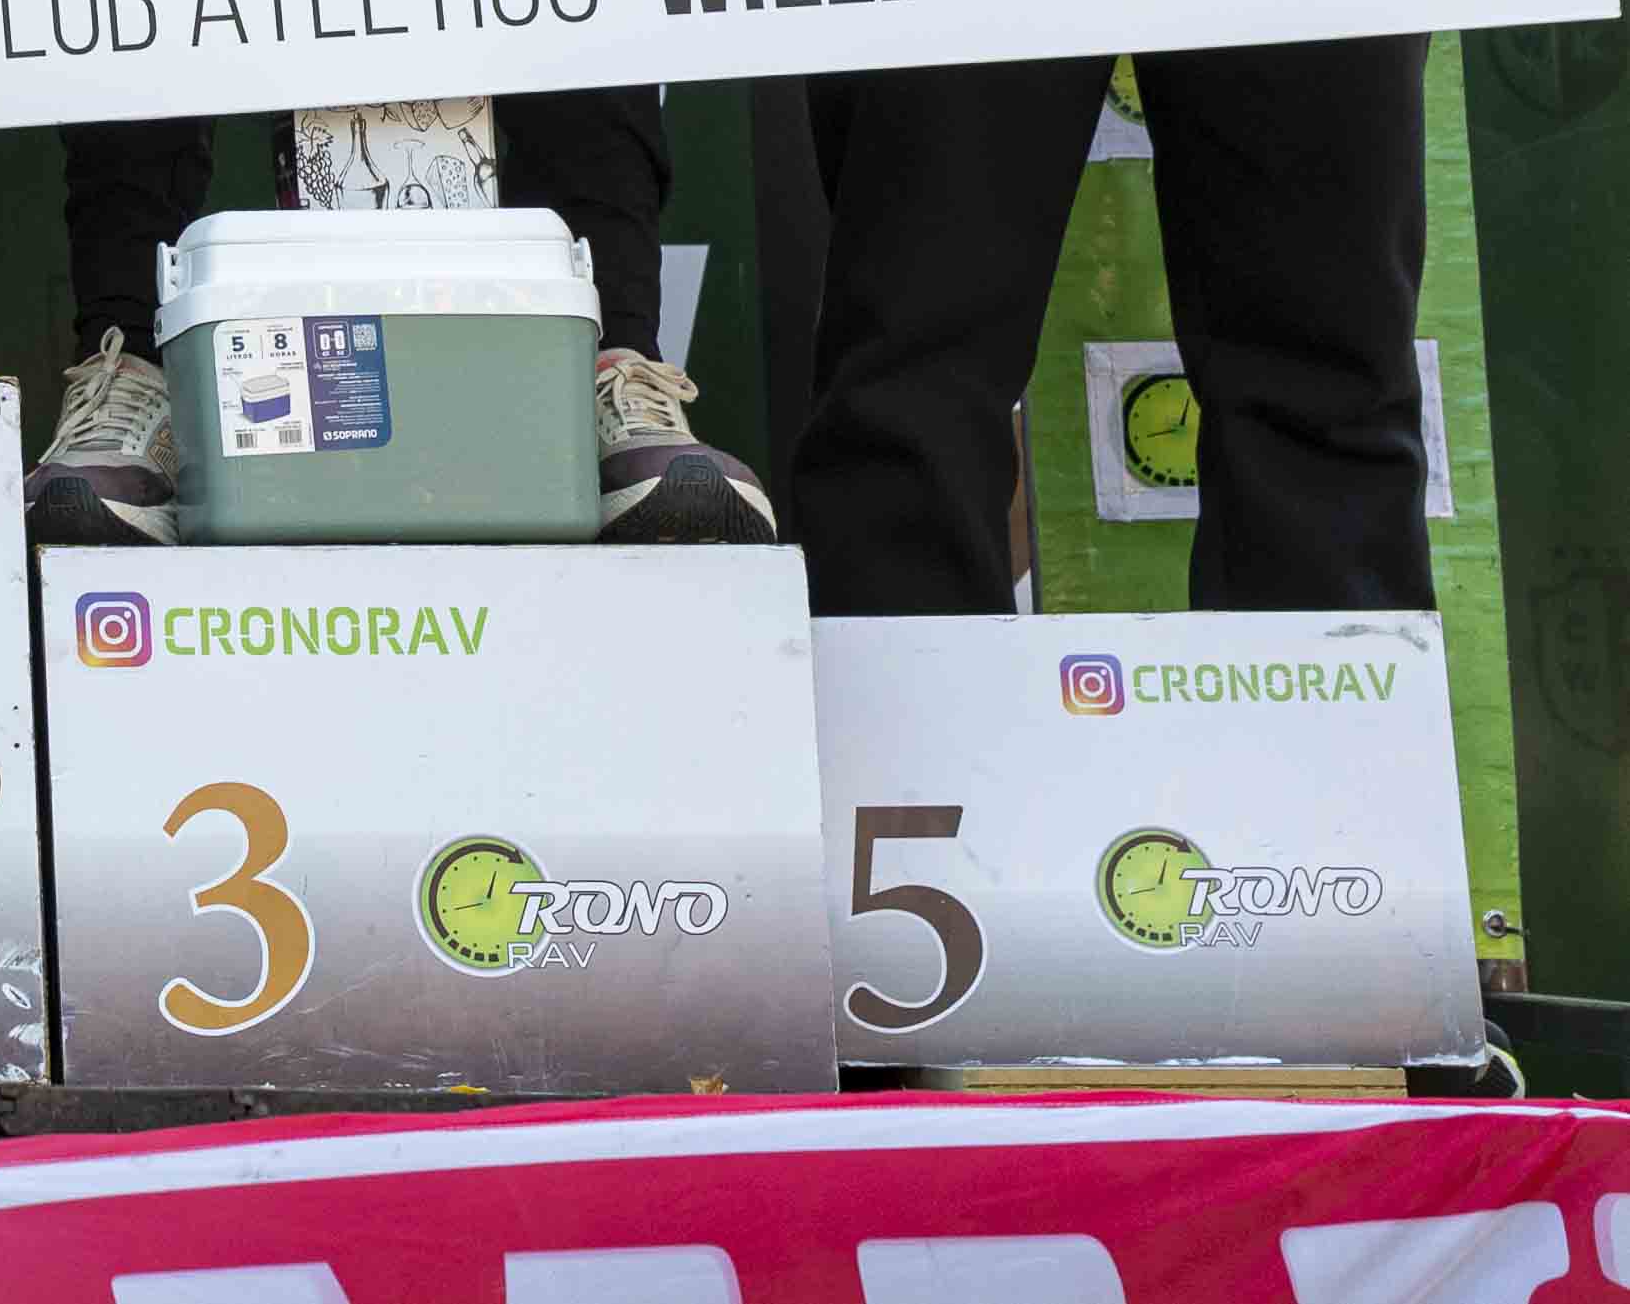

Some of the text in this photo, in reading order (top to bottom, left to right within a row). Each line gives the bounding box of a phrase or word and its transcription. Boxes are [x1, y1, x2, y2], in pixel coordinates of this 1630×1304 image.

[232, 333, 288, 352] 5 8
[332, 428, 378, 441] SOPRANO
[164, 606, 489, 657] CRONORAV
[1133, 661, 1397, 703] CRONORAV
[157, 781, 317, 1038] 3
[843, 803, 987, 1035] 5
[1179, 921, 1264, 948] RAV
[507, 941, 597, 970] RAV
